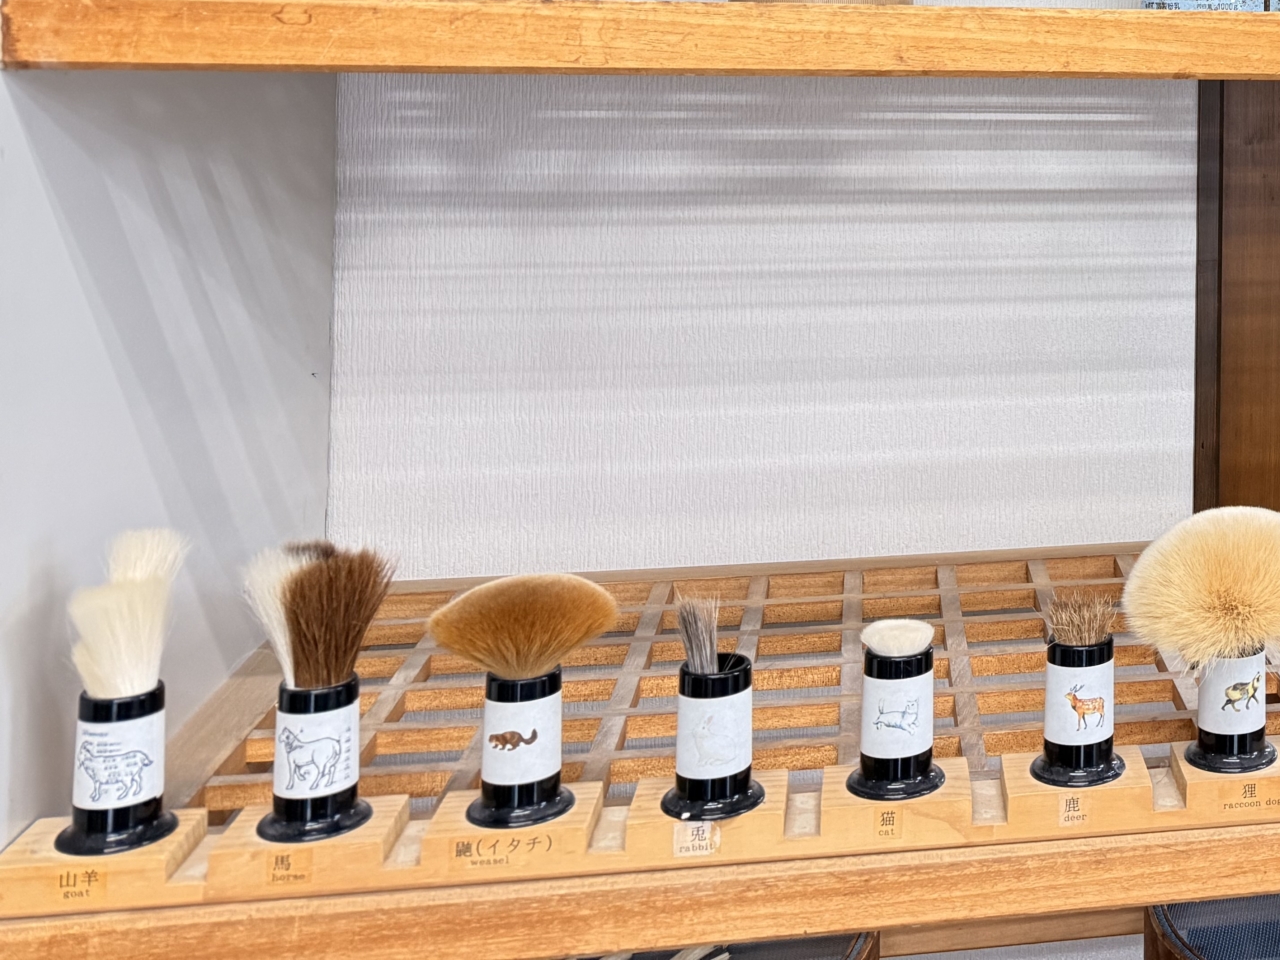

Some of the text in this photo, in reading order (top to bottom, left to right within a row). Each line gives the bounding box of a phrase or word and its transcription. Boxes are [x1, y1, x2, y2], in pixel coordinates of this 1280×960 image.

[1242, 783, 1257, 799] 狸
[1064, 796, 1080, 814] 鹿
[1223, 798, 1261, 810] raccoon
[880, 810, 896, 828] 猫
[1063, 812, 1087, 822] deer
[691, 826, 707, 842] 兎
[878, 827, 895, 837] cat
[679, 841, 715, 853] rabbit
[273, 854, 291, 871] 馬
[470, 855, 510, 866] weasel
[59, 870, 99, 888] 山羊
[271, 871, 305, 881] horse
[63, 888, 91, 899] goat
